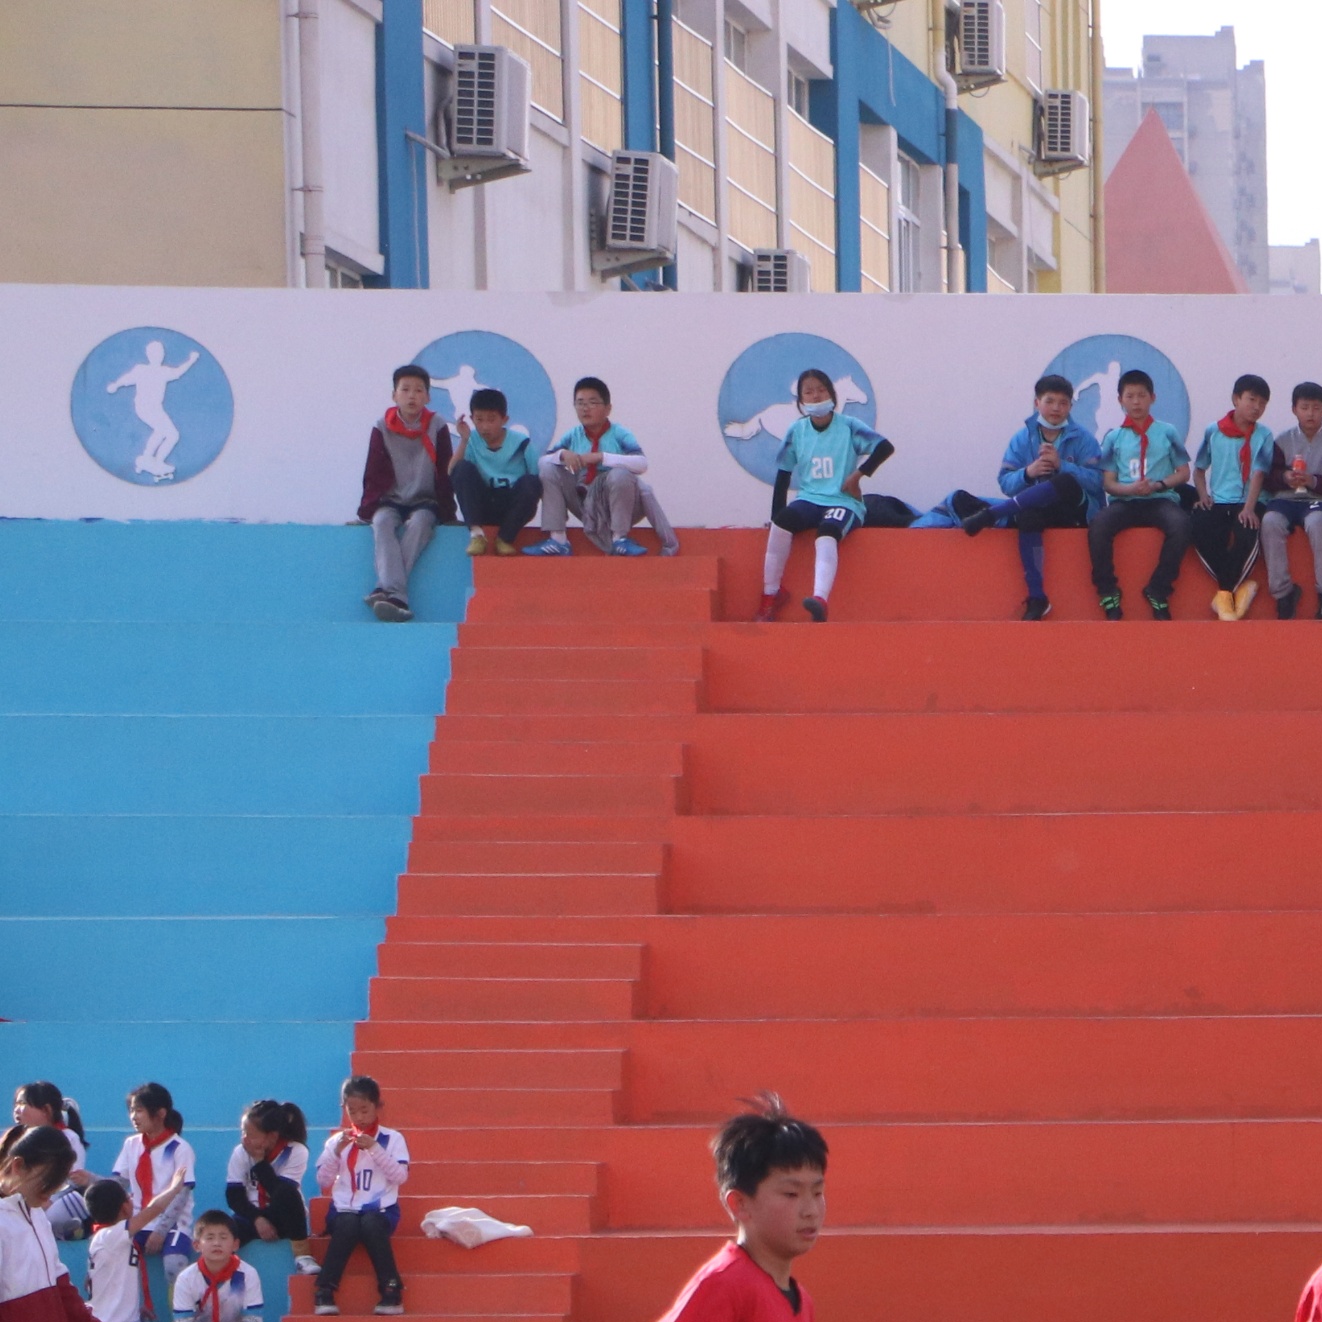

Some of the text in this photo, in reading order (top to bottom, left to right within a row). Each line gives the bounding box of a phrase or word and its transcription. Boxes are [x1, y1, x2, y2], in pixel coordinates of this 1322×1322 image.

[811, 456, 834, 479] 20
[356, 1169, 373, 1191] 10
[169, 1229, 181, 1247] 7
